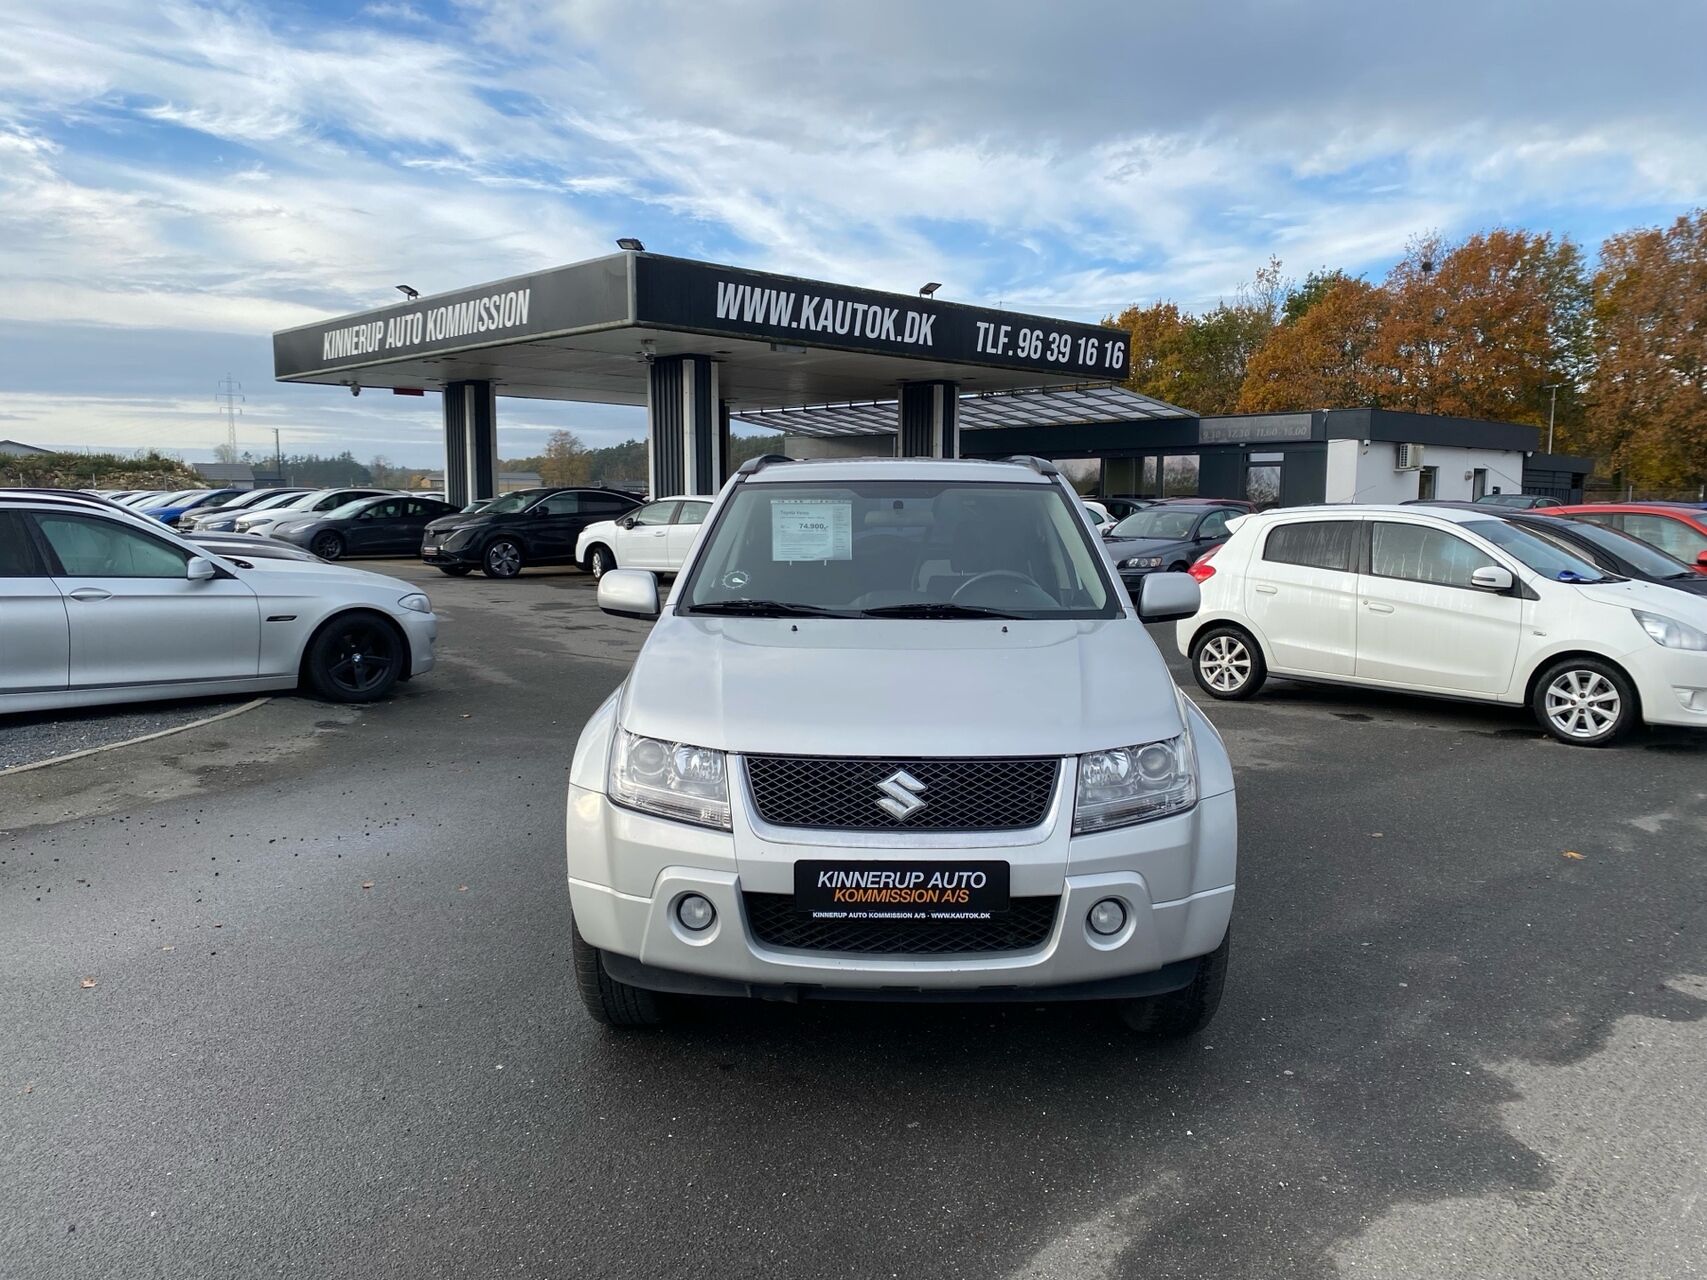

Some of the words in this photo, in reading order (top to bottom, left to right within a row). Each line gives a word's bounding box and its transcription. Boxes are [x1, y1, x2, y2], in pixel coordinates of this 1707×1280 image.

[323, 321, 384, 360] KINNERUP
[385, 312, 423, 349] AUTO
[426, 289, 530, 342] KOMMISSION
[716, 281, 937, 346] WWW.KAUTOK.DK
[976, 321, 1013, 356] TLF.
[1017, 328, 1044, 360] 96
[1046, 332, 1072, 363] 39
[1077, 337, 1098, 366] 16
[1104, 340, 1125, 369] 16
[817, 871, 924, 888] KINNERUP
[927, 871, 986, 889] AUTO
[834, 889, 939, 903] KOMMISSION
[941, 889, 970, 903] A/S
[812, 911, 848, 919] KINNERUP
[848, 911, 868, 919] AUTO
[868, 911, 913, 919] KOMMISSION
[914, 911, 926, 919] A/S
[931, 911, 991, 919] WWW.KAUTOK.DK
